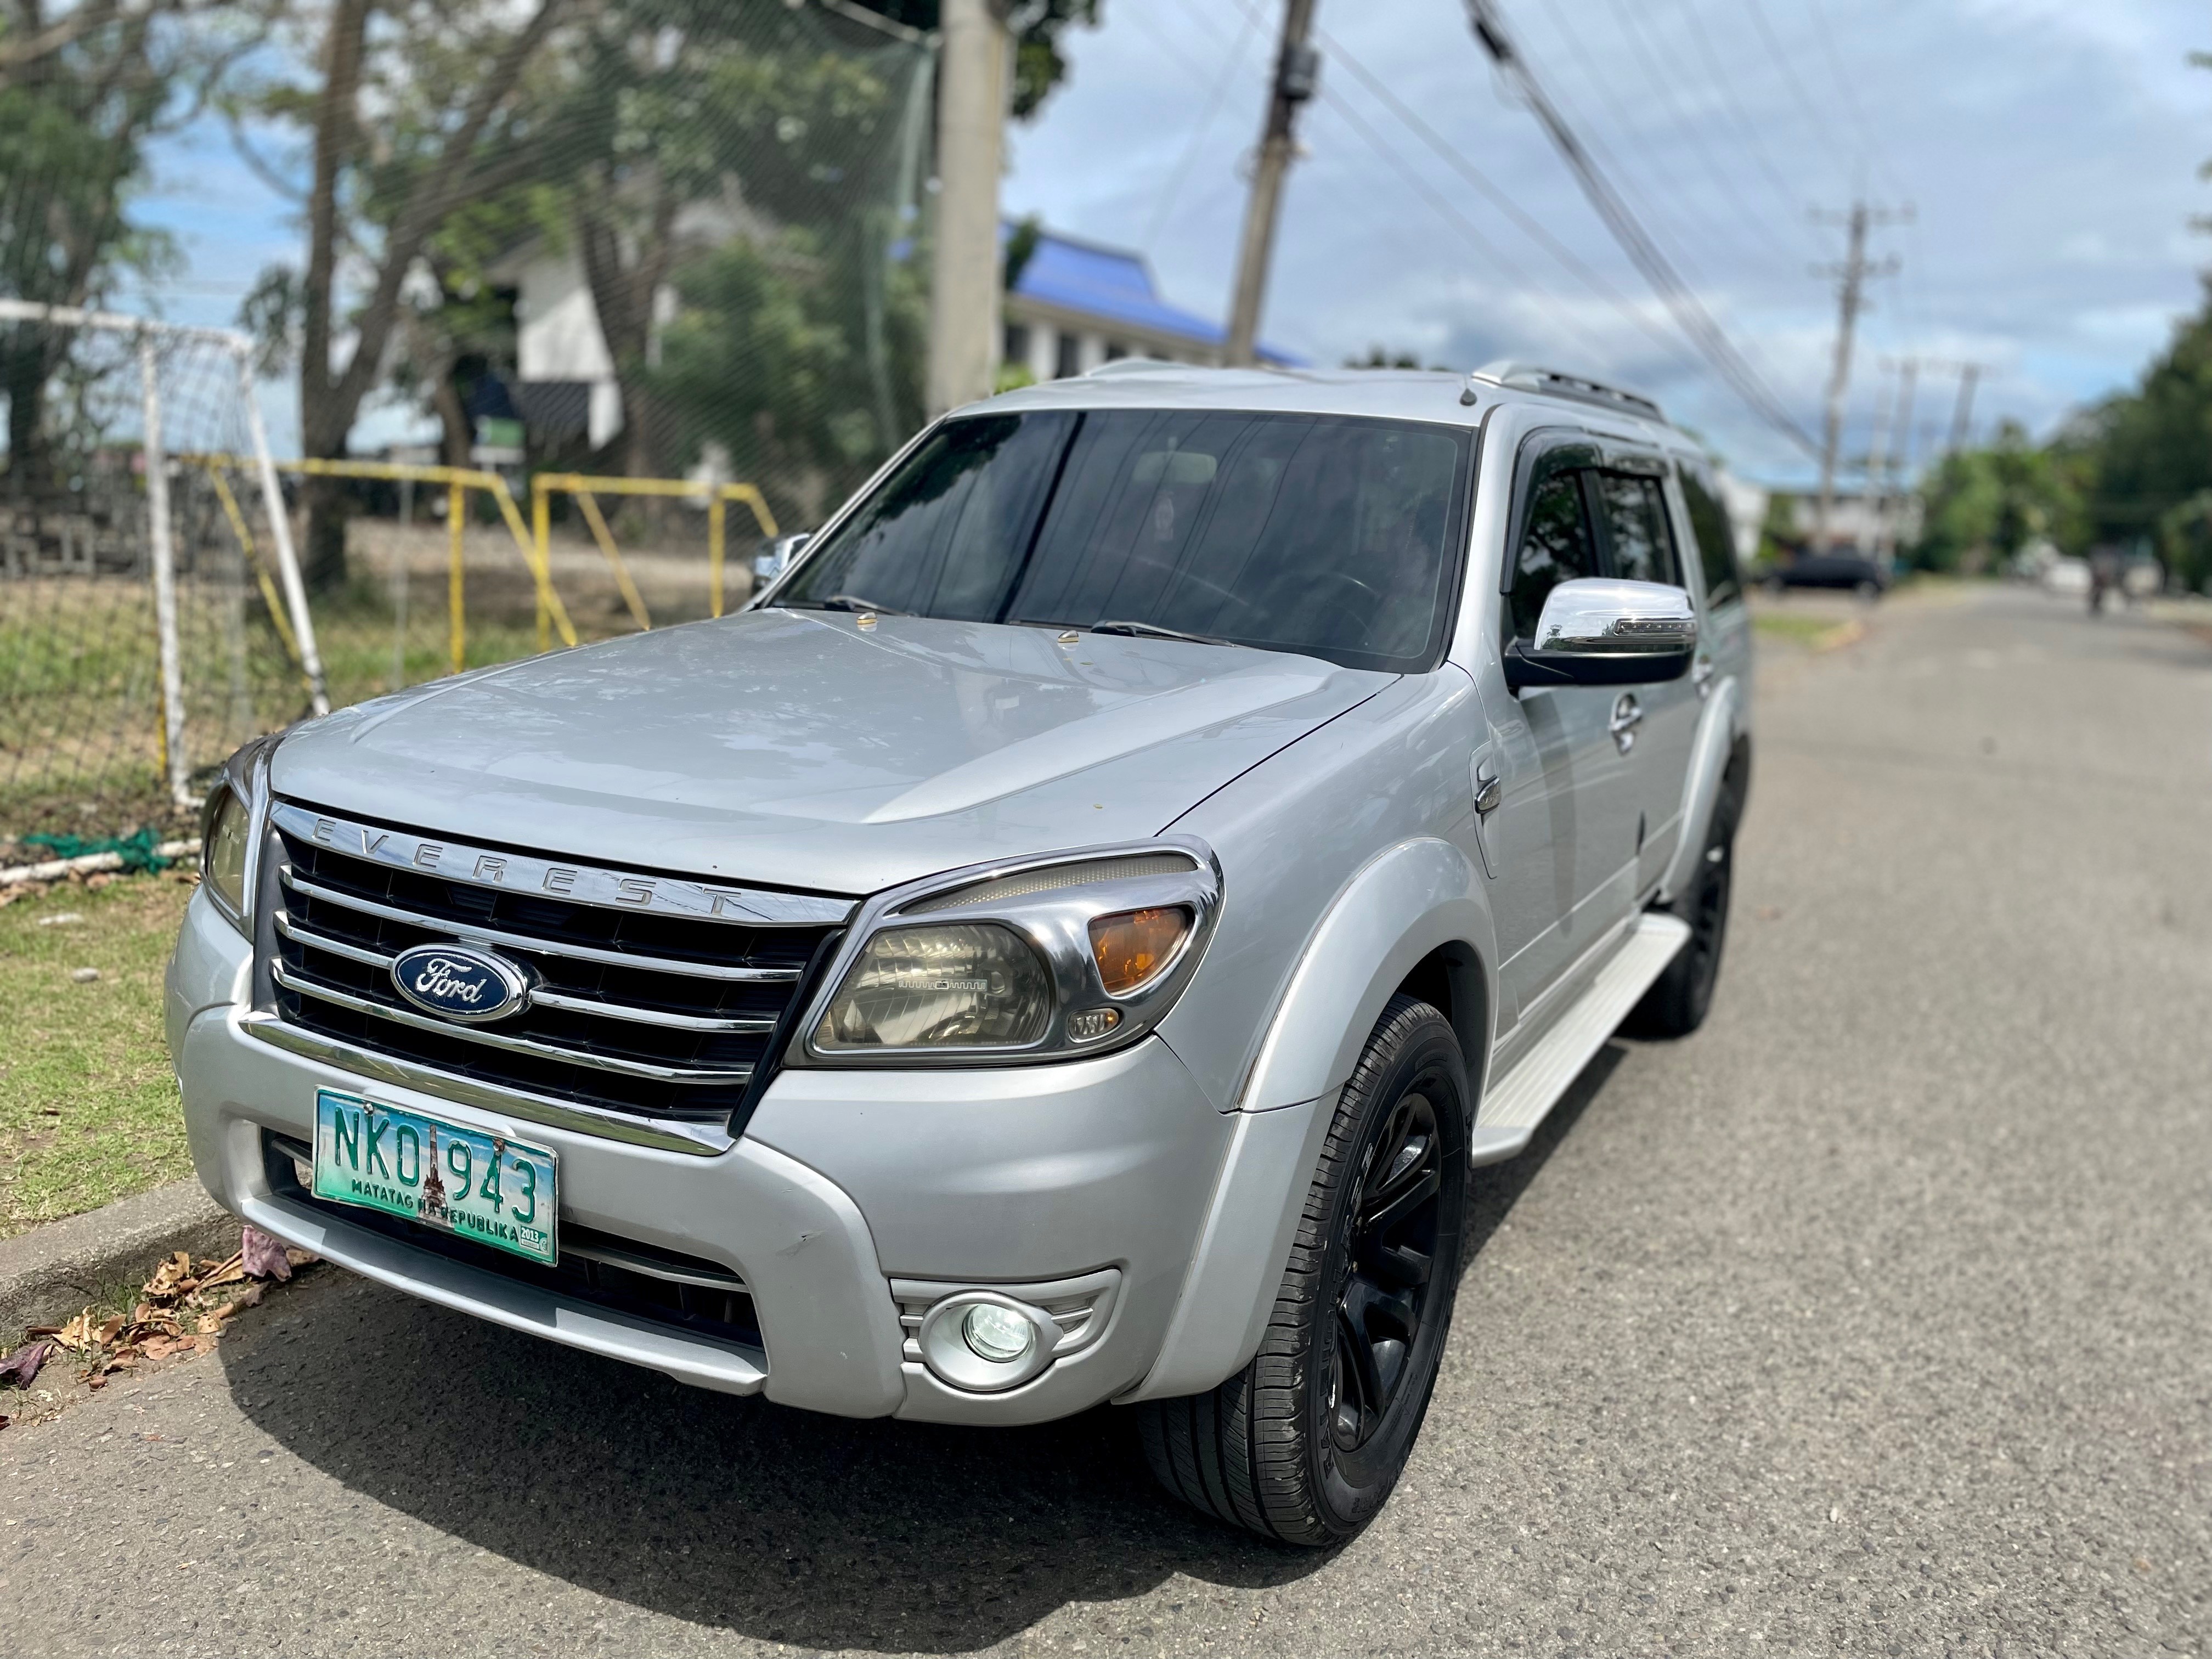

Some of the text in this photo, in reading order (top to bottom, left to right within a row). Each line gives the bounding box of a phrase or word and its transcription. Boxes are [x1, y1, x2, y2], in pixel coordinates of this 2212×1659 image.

[311, 818, 742, 916] EVEREST
[415, 958, 487, 1003] Ford
[352, 1178, 519, 1243] MATATAG NA REPUBLIKA
[447, 1139, 537, 1224] 943
[521, 1226, 539, 1243] 2013
